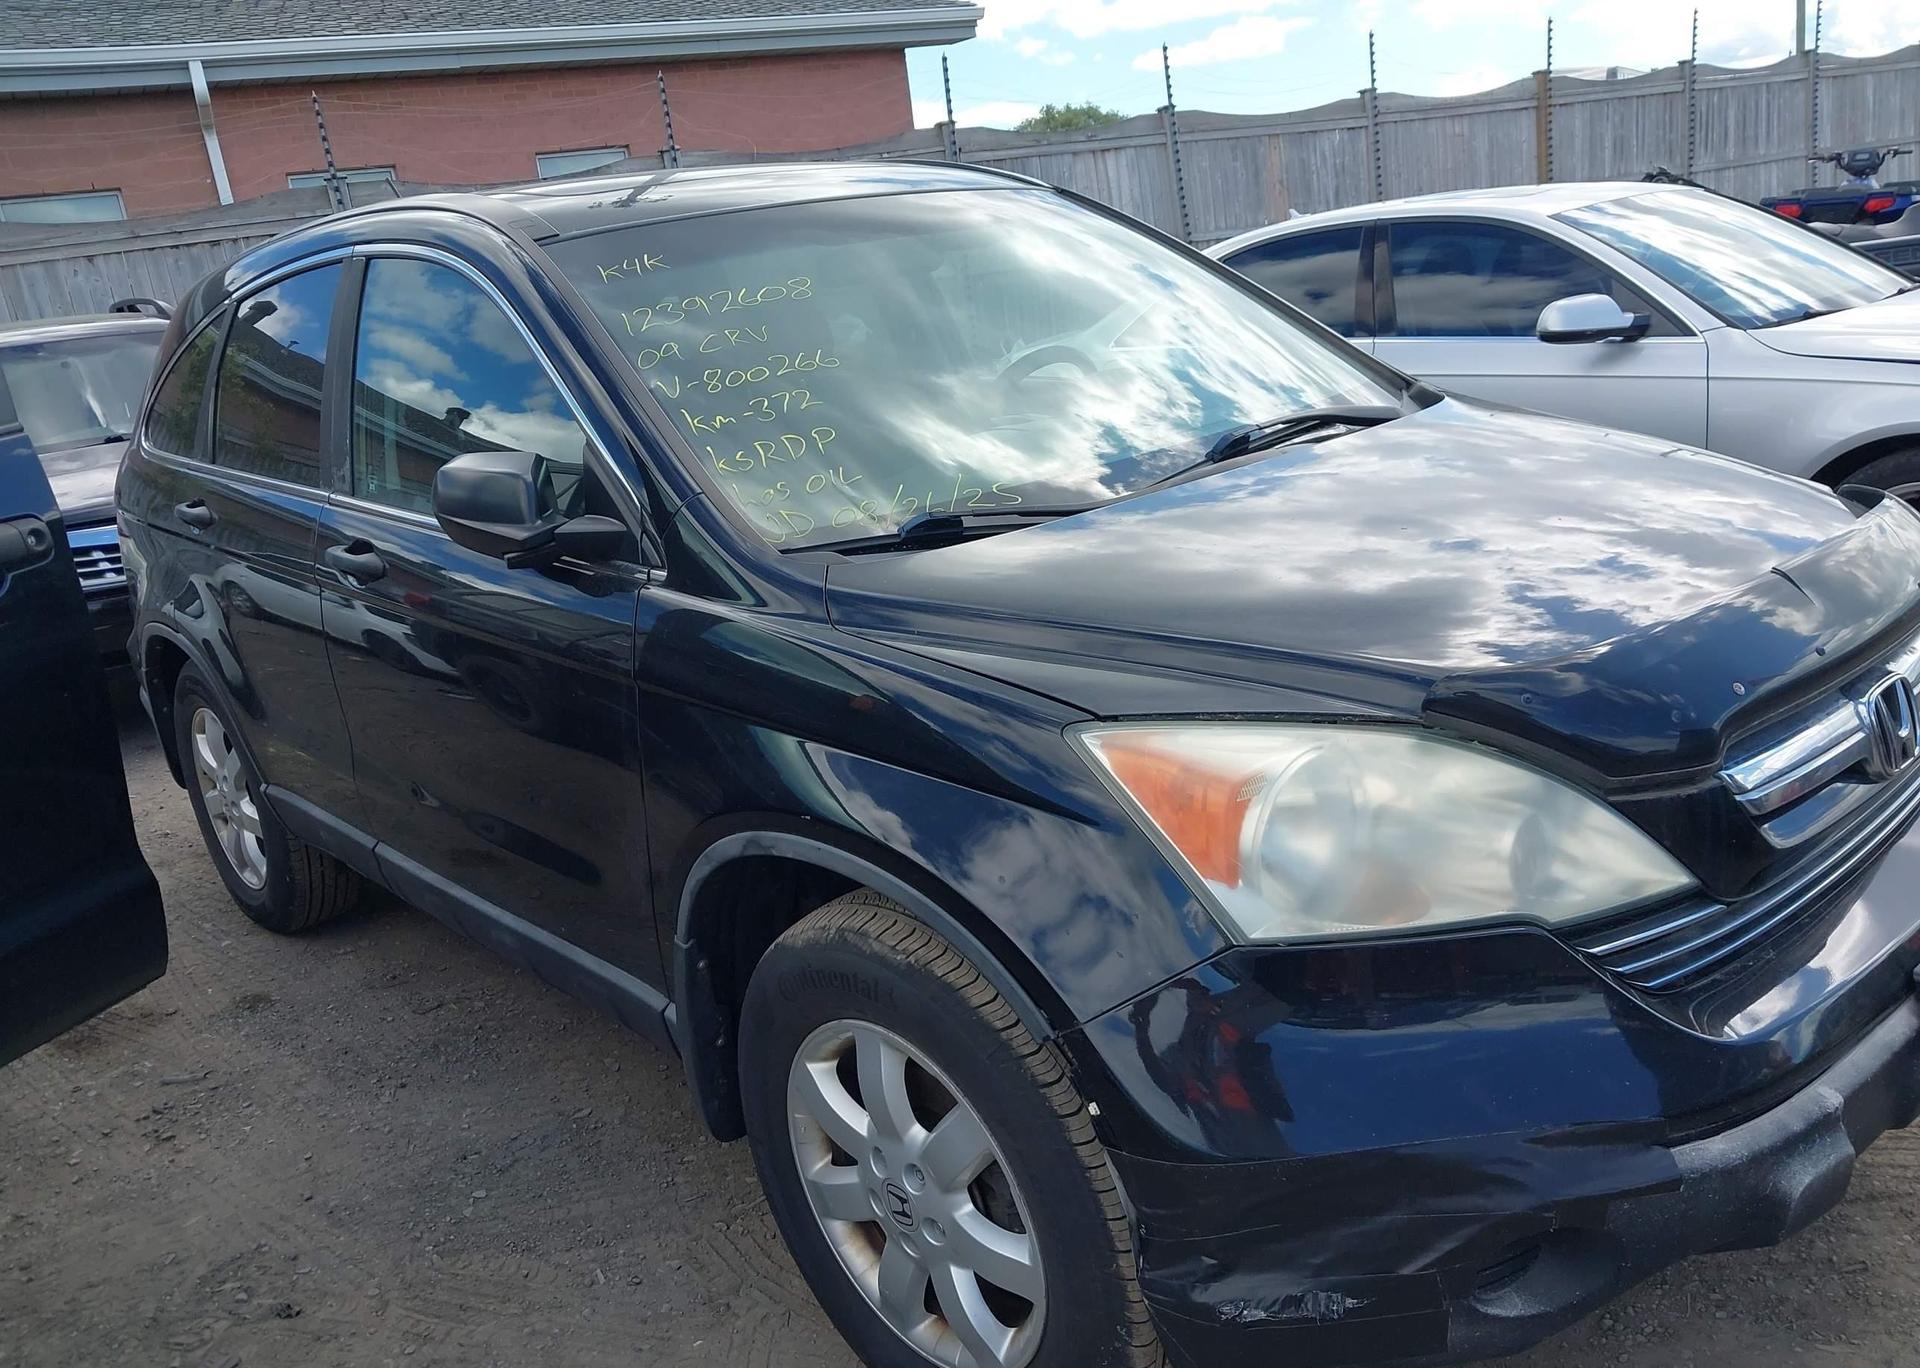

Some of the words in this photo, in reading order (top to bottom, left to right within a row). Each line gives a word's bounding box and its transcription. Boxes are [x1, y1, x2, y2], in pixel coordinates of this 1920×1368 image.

[621, 276, 812, 337] 12392608
[699, 325, 768, 353] CRV
[656, 349, 840, 399] V-800266
[806, 466, 863, 494] OIL
